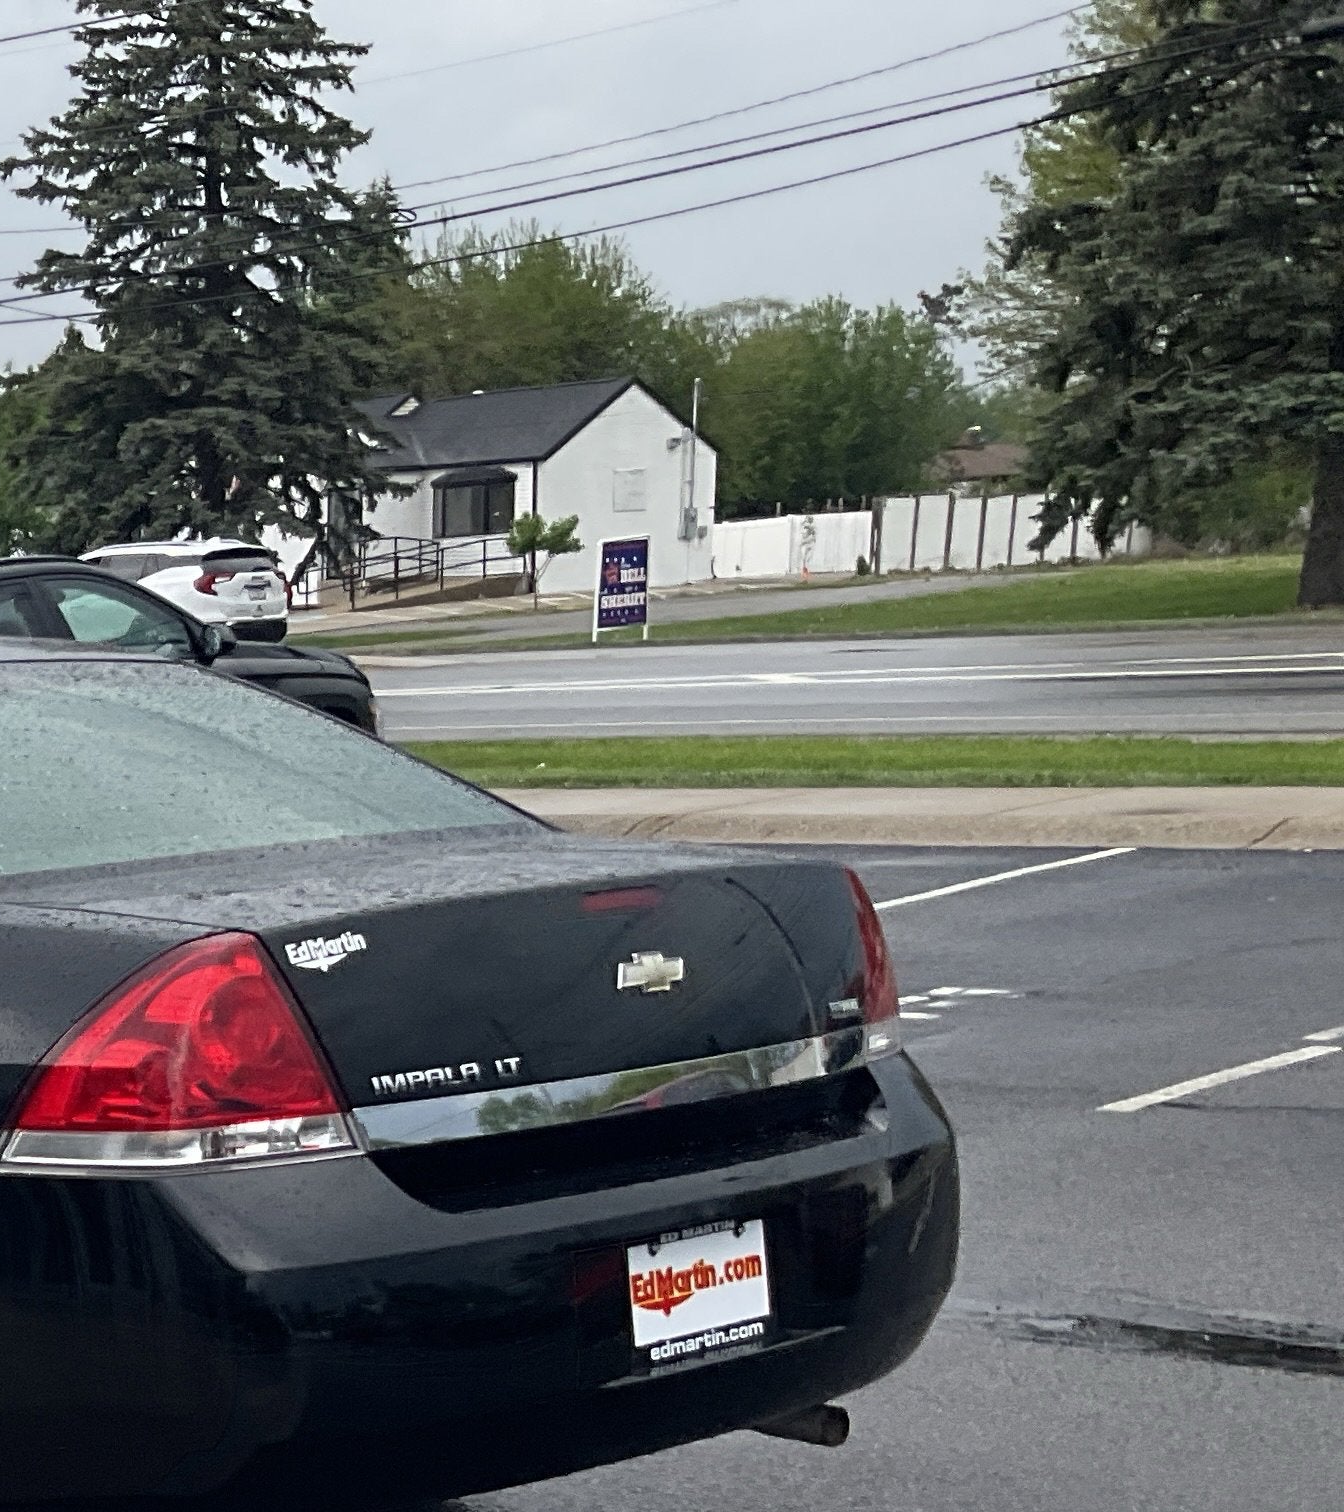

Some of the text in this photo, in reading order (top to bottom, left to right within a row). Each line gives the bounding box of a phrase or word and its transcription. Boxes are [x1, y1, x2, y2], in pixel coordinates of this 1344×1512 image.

[371, 1057, 521, 1096] IMPALA LT
[650, 1321, 764, 1361] edmartin.com
